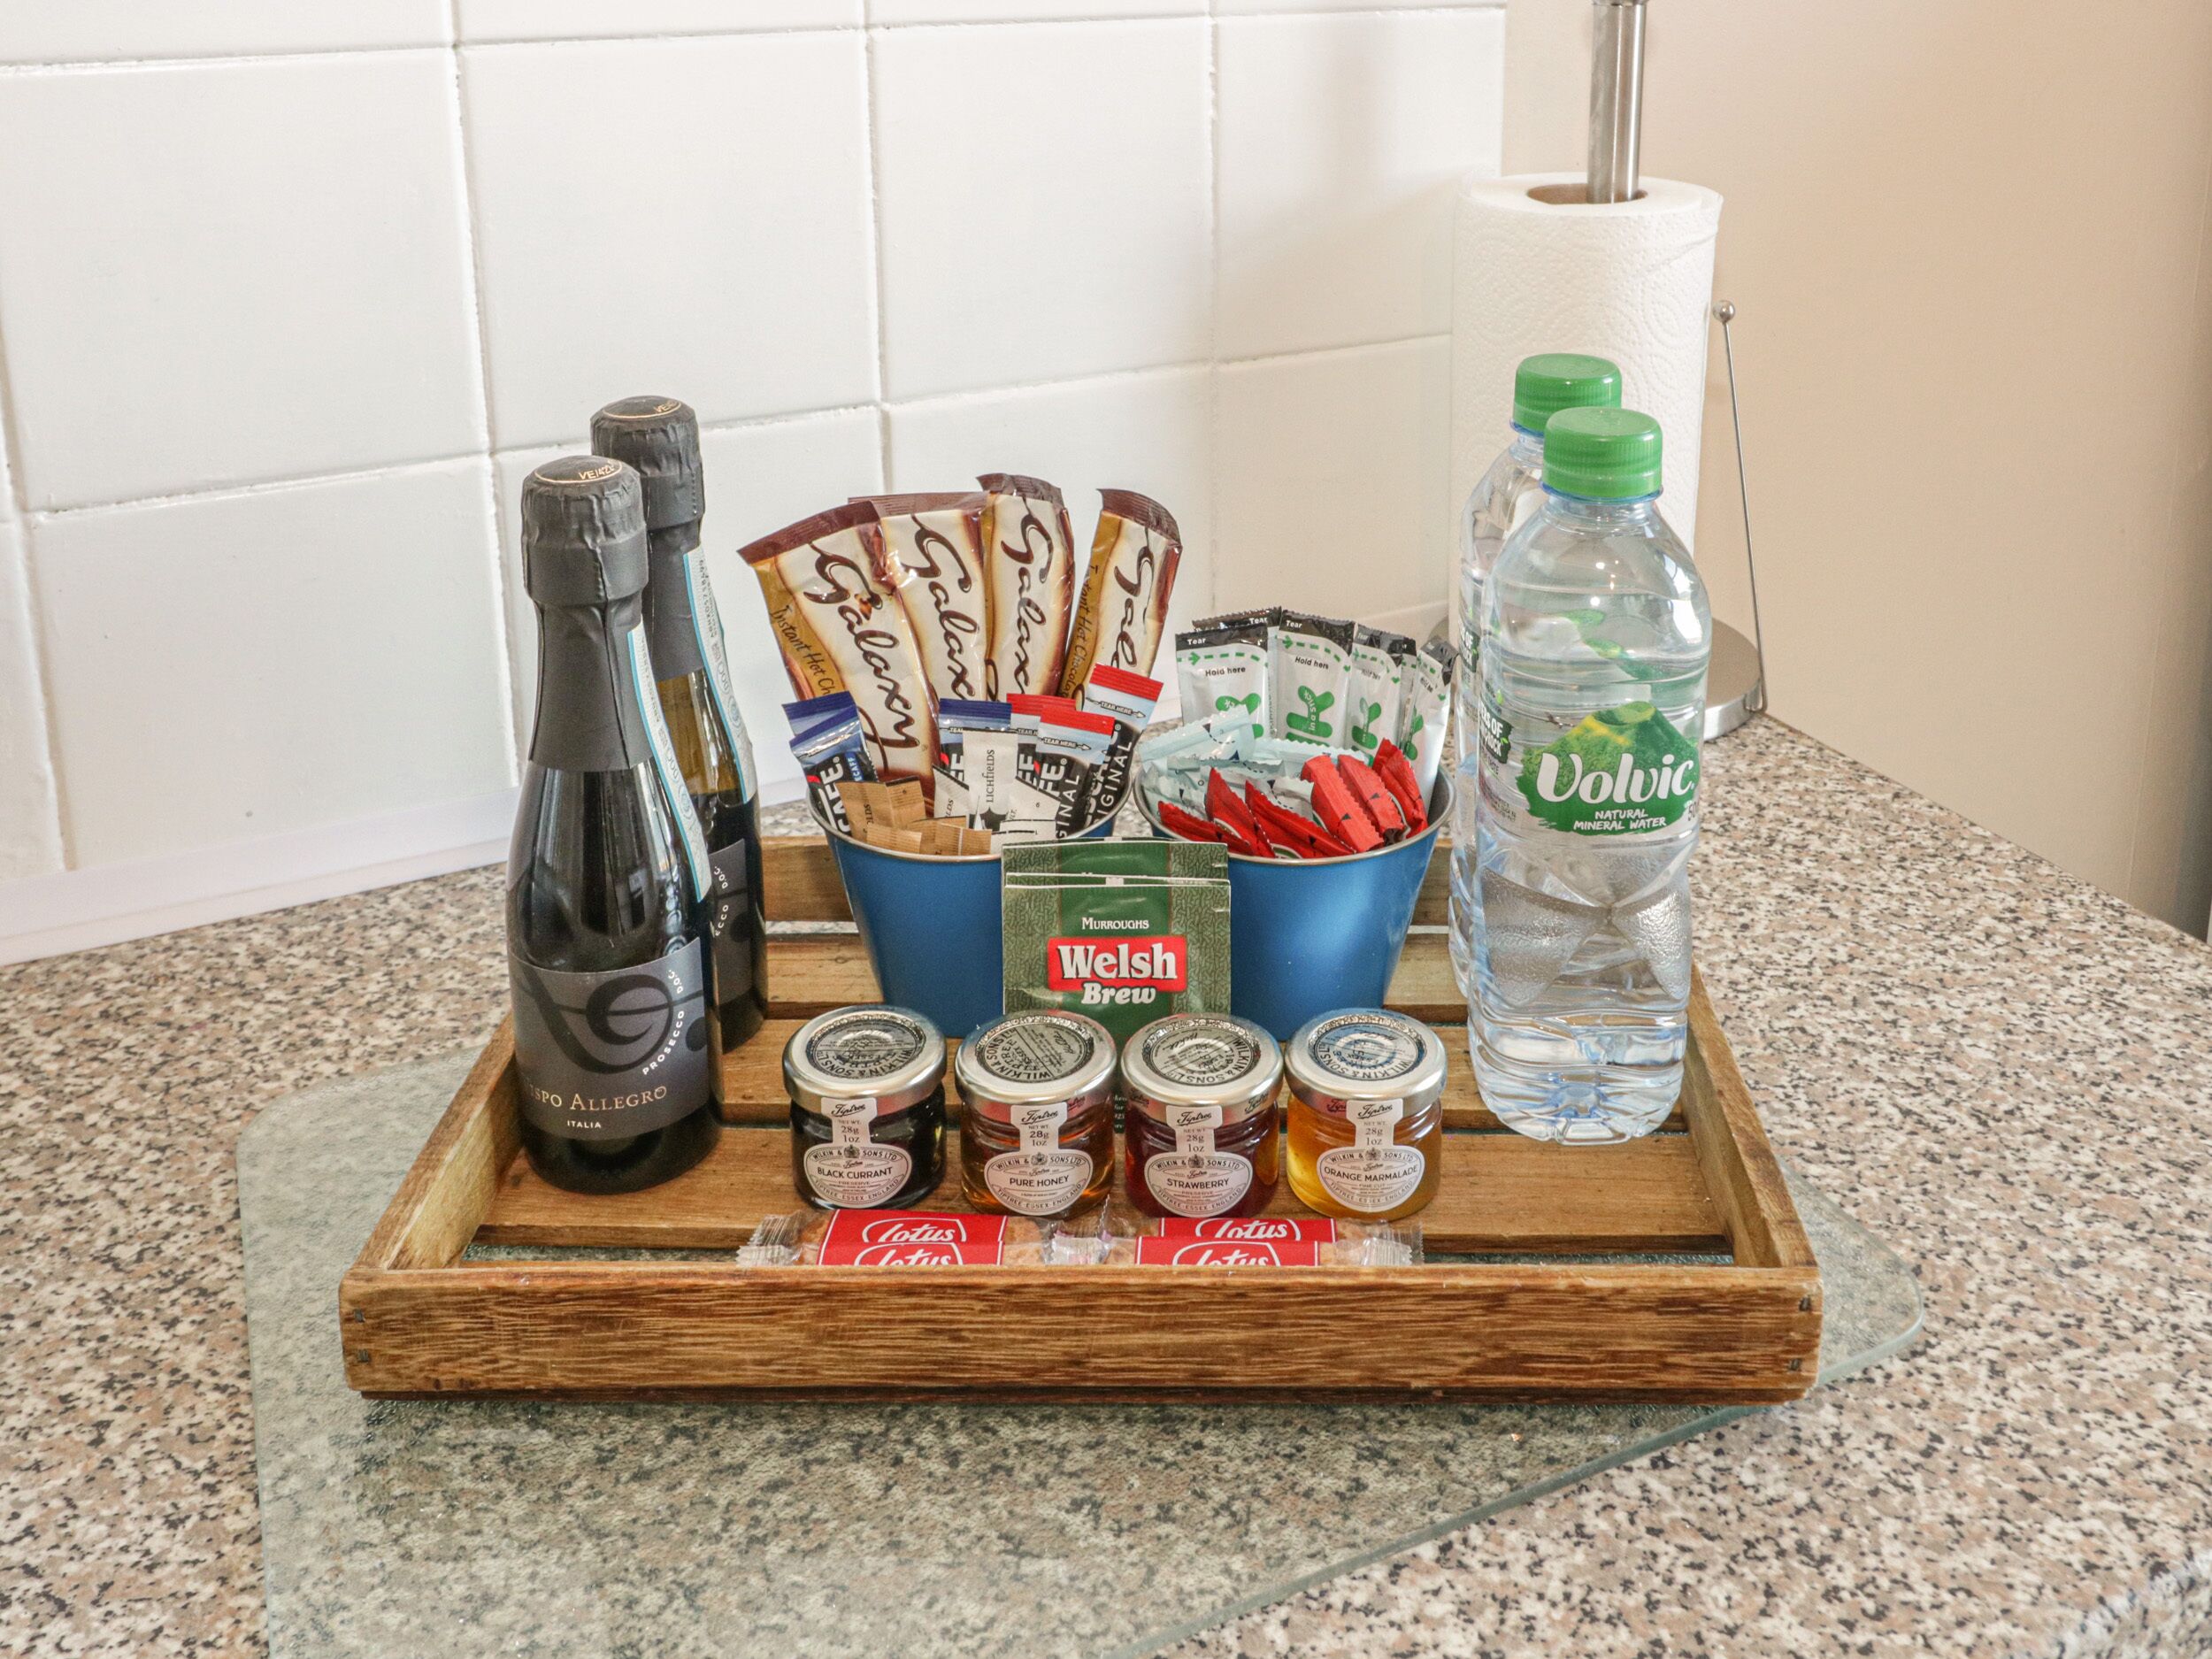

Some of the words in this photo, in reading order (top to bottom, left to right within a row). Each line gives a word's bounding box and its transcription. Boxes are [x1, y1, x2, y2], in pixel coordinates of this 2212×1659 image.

[993, 497, 1054, 697] Galax
[901, 514, 979, 701] Galax
[770, 603, 811, 657] Instant
[803, 650, 826, 676] Hot
[803, 542, 920, 757] Galaxy
[1295, 657, 1312, 666] Hold
[1314, 660, 1329, 671] here
[1101, 700, 1117, 710] TEAR
[1117, 705, 1133, 715] HERE
[1491, 718, 1503, 738] OF
[1060, 740, 1077, 749] HERE
[1536, 752, 1694, 804] Volvic
[1594, 808, 1648, 820] NATURAL
[1573, 819, 1624, 831] MINERAL
[1630, 817, 1667, 829] WATER
[1057, 942, 1178, 979] Welsh
[1081, 982, 1156, 1004] Brew
[642, 1010, 685, 1075] PROSECCO
[986, 1035, 1003, 1060] SONS
[1233, 1039, 1250, 1071] WILKIN
[1319, 1053, 1348, 1074] SONS
[1362, 1059, 1411, 1079] WILKIN
[998, 1064, 1051, 1080] WILKIN
[1187, 1073, 1225, 1084] SONS
[570, 1085, 667, 1111] ALLEGRO
[832, 1103, 866, 1118] Tiptree
[1020, 1109, 1058, 1125] Tiptree
[1356, 1103, 1394, 1119] Tiptree
[567, 1120, 602, 1129] ITALIA
[1176, 1111, 1212, 1126] Tiptree
[841, 1125, 859, 1134] 28g
[1030, 1130, 1049, 1139] 28g
[1365, 1127, 1384, 1136] 28g
[843, 1134, 861, 1143] 1oz
[1187, 1134, 1204, 1143] 28g
[813, 1149, 833, 1160] WILKIN
[885, 1152, 897, 1161] LTD
[996, 1157, 1020, 1169] WILKIN
[1070, 1156, 1082, 1165] LTD
[1330, 1153, 1355, 1163] WILKIN
[1403, 1153, 1415, 1162] LTD
[1156, 1159, 1178, 1169] WILKIN
[1228, 1161, 1240, 1170] LTD
[817, 1166, 844, 1179] BLACK
[846, 1166, 893, 1179] CURRANT
[1324, 1166, 1362, 1181] ORANGE
[1364, 1165, 1418, 1182] MARMALADE
[1010, 1177, 1034, 1187] PURE
[1037, 1175, 1070, 1187] HONEY
[1167, 1178, 1229, 1189] STRAWBERRY
